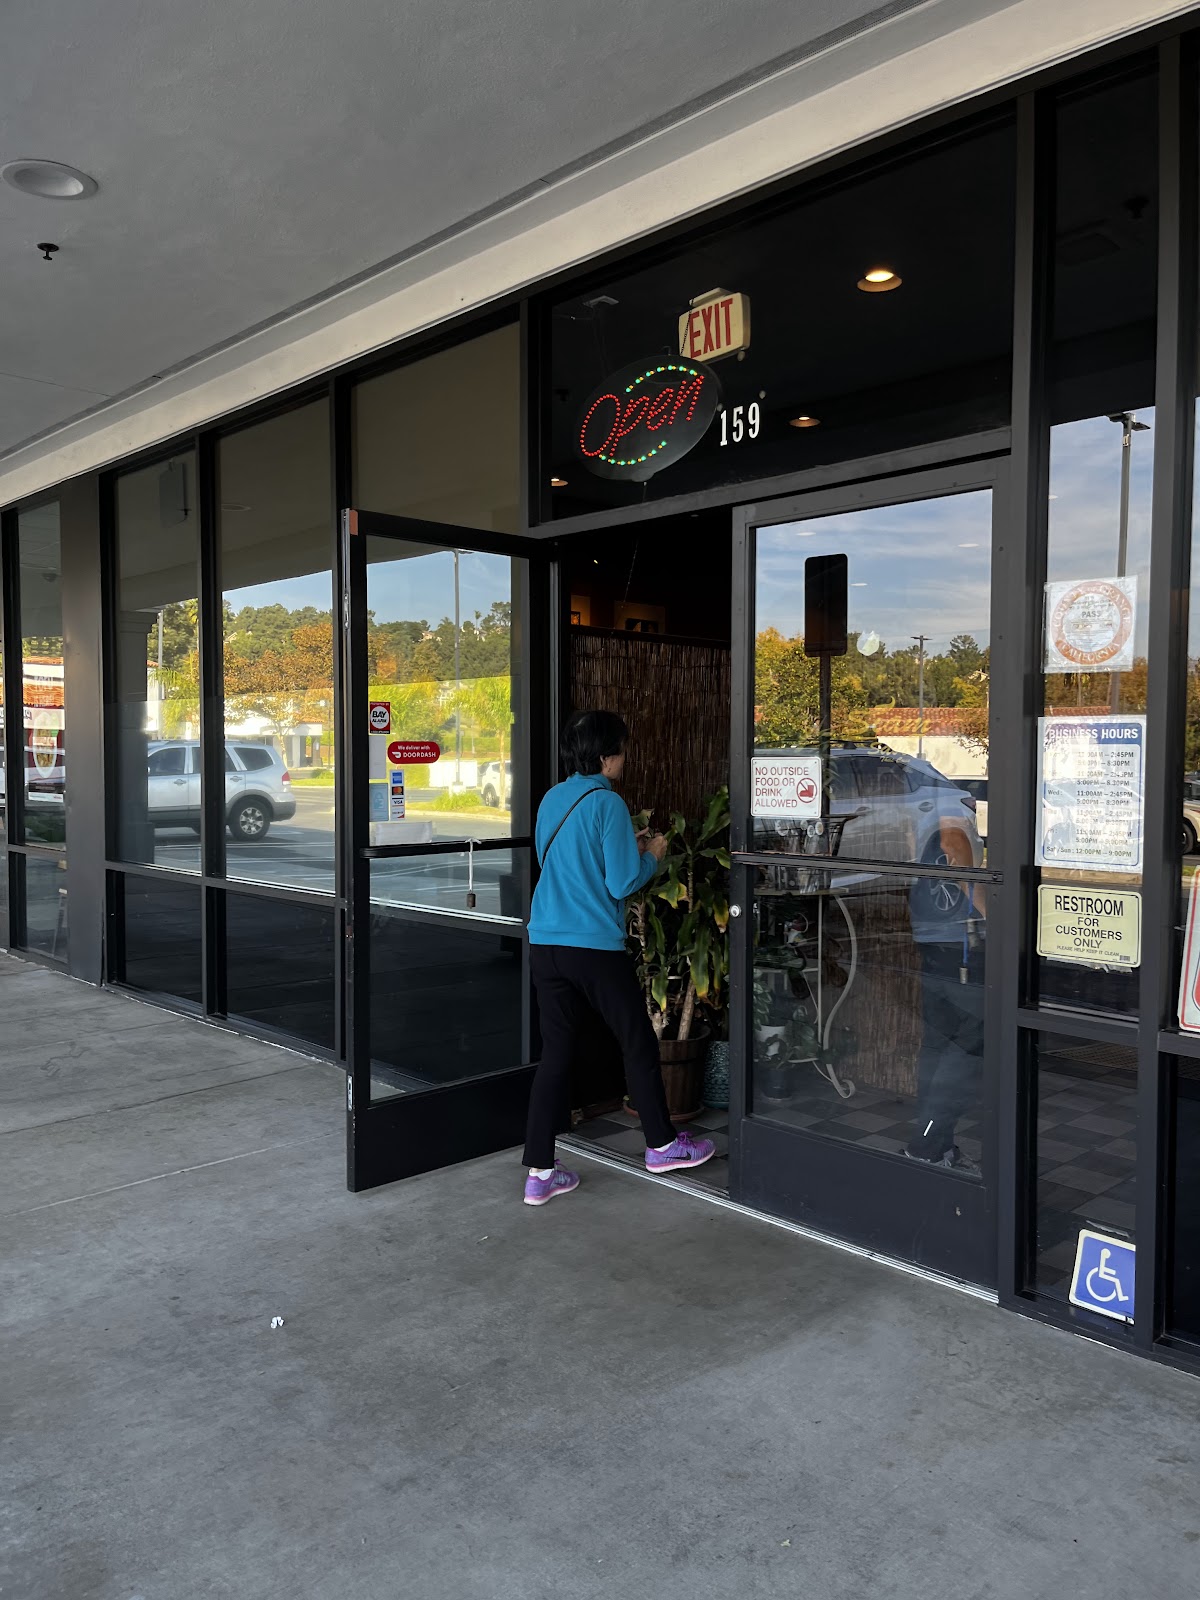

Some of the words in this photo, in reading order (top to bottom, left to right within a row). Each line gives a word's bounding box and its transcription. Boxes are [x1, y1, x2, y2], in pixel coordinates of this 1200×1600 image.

[689, 298, 733, 359] EXIT
[580, 375, 704, 457] Open
[720, 402, 760, 446] 159
[1049, 728, 1098, 739] BUSINESS
[1101, 728, 1139, 739] HOURS
[755, 767, 768, 776] NO
[770, 767, 809, 776] OUTSIDE
[755, 778, 780, 786] FOOD
[782, 778, 795, 786] OR
[755, 788, 782, 796] DRINK
[755, 799, 798, 807] ALLOWED
[1055, 895, 1124, 916] RESTROOM
[1077, 917, 1099, 927] FOR
[1055, 925, 1123, 940] CUSTOMERS
[1073, 937, 1102, 949] ONLY
